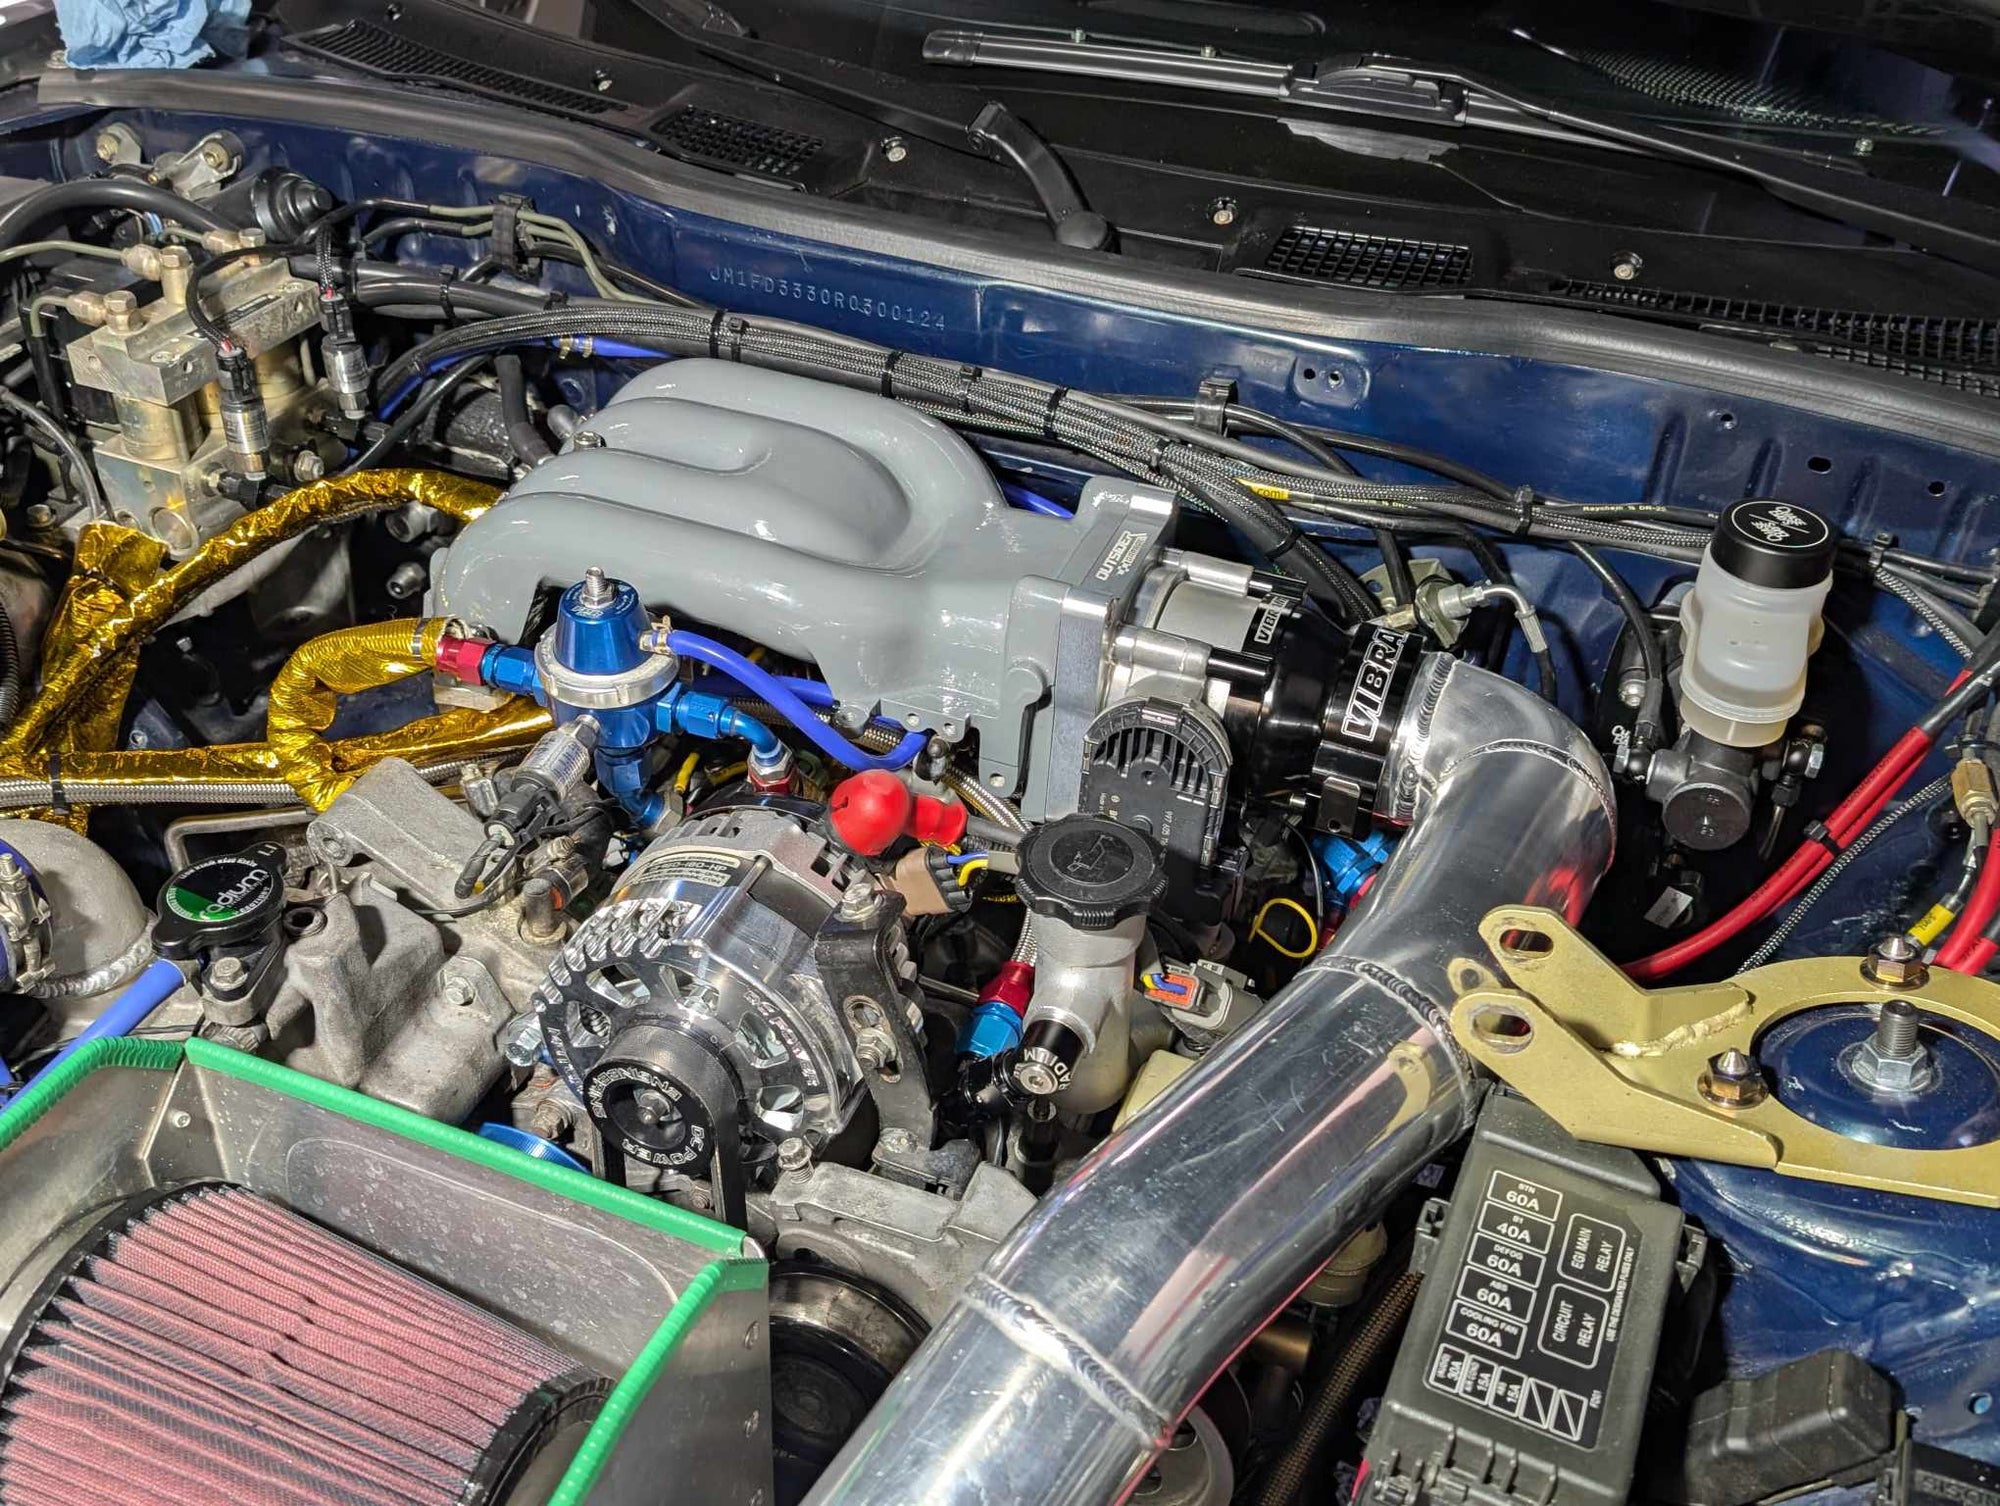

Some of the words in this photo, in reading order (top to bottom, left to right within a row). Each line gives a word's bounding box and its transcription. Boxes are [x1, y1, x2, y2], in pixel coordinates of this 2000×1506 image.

[710, 267, 945, 331] JM1FD3330R0300124
[199, 868, 269, 920] radium
[1023, 1048, 1073, 1093] RADIUM
[588, 1067, 682, 1119] ENGINEERING
[690, 1124, 705, 1151] DC
[622, 1138, 698, 1165] POWER
[1505, 1190, 1540, 1211] 60A
[1496, 1221, 1532, 1244] 40A
[1576, 1227, 1593, 1250] MAIN
[1494, 1243, 1524, 1260] DEFOG
[1571, 1249, 1585, 1270] EGI
[1595, 1241, 1614, 1272] RELAY
[1486, 1254, 1522, 1277] 60A
[1476, 1288, 1512, 1312] 60A
[1460, 1306, 1500, 1329] COOLING
[1498, 1319, 1519, 1335] FAN
[1552, 1300, 1574, 1342] CIRCUIT
[1577, 1312, 1597, 1348] RELAY
[1466, 1323, 1502, 1347] 60A
[1447, 1360, 1461, 1381] 30A
[1476, 1372, 1491, 1392] 15A
[1506, 1383, 1521, 1403] 15A
